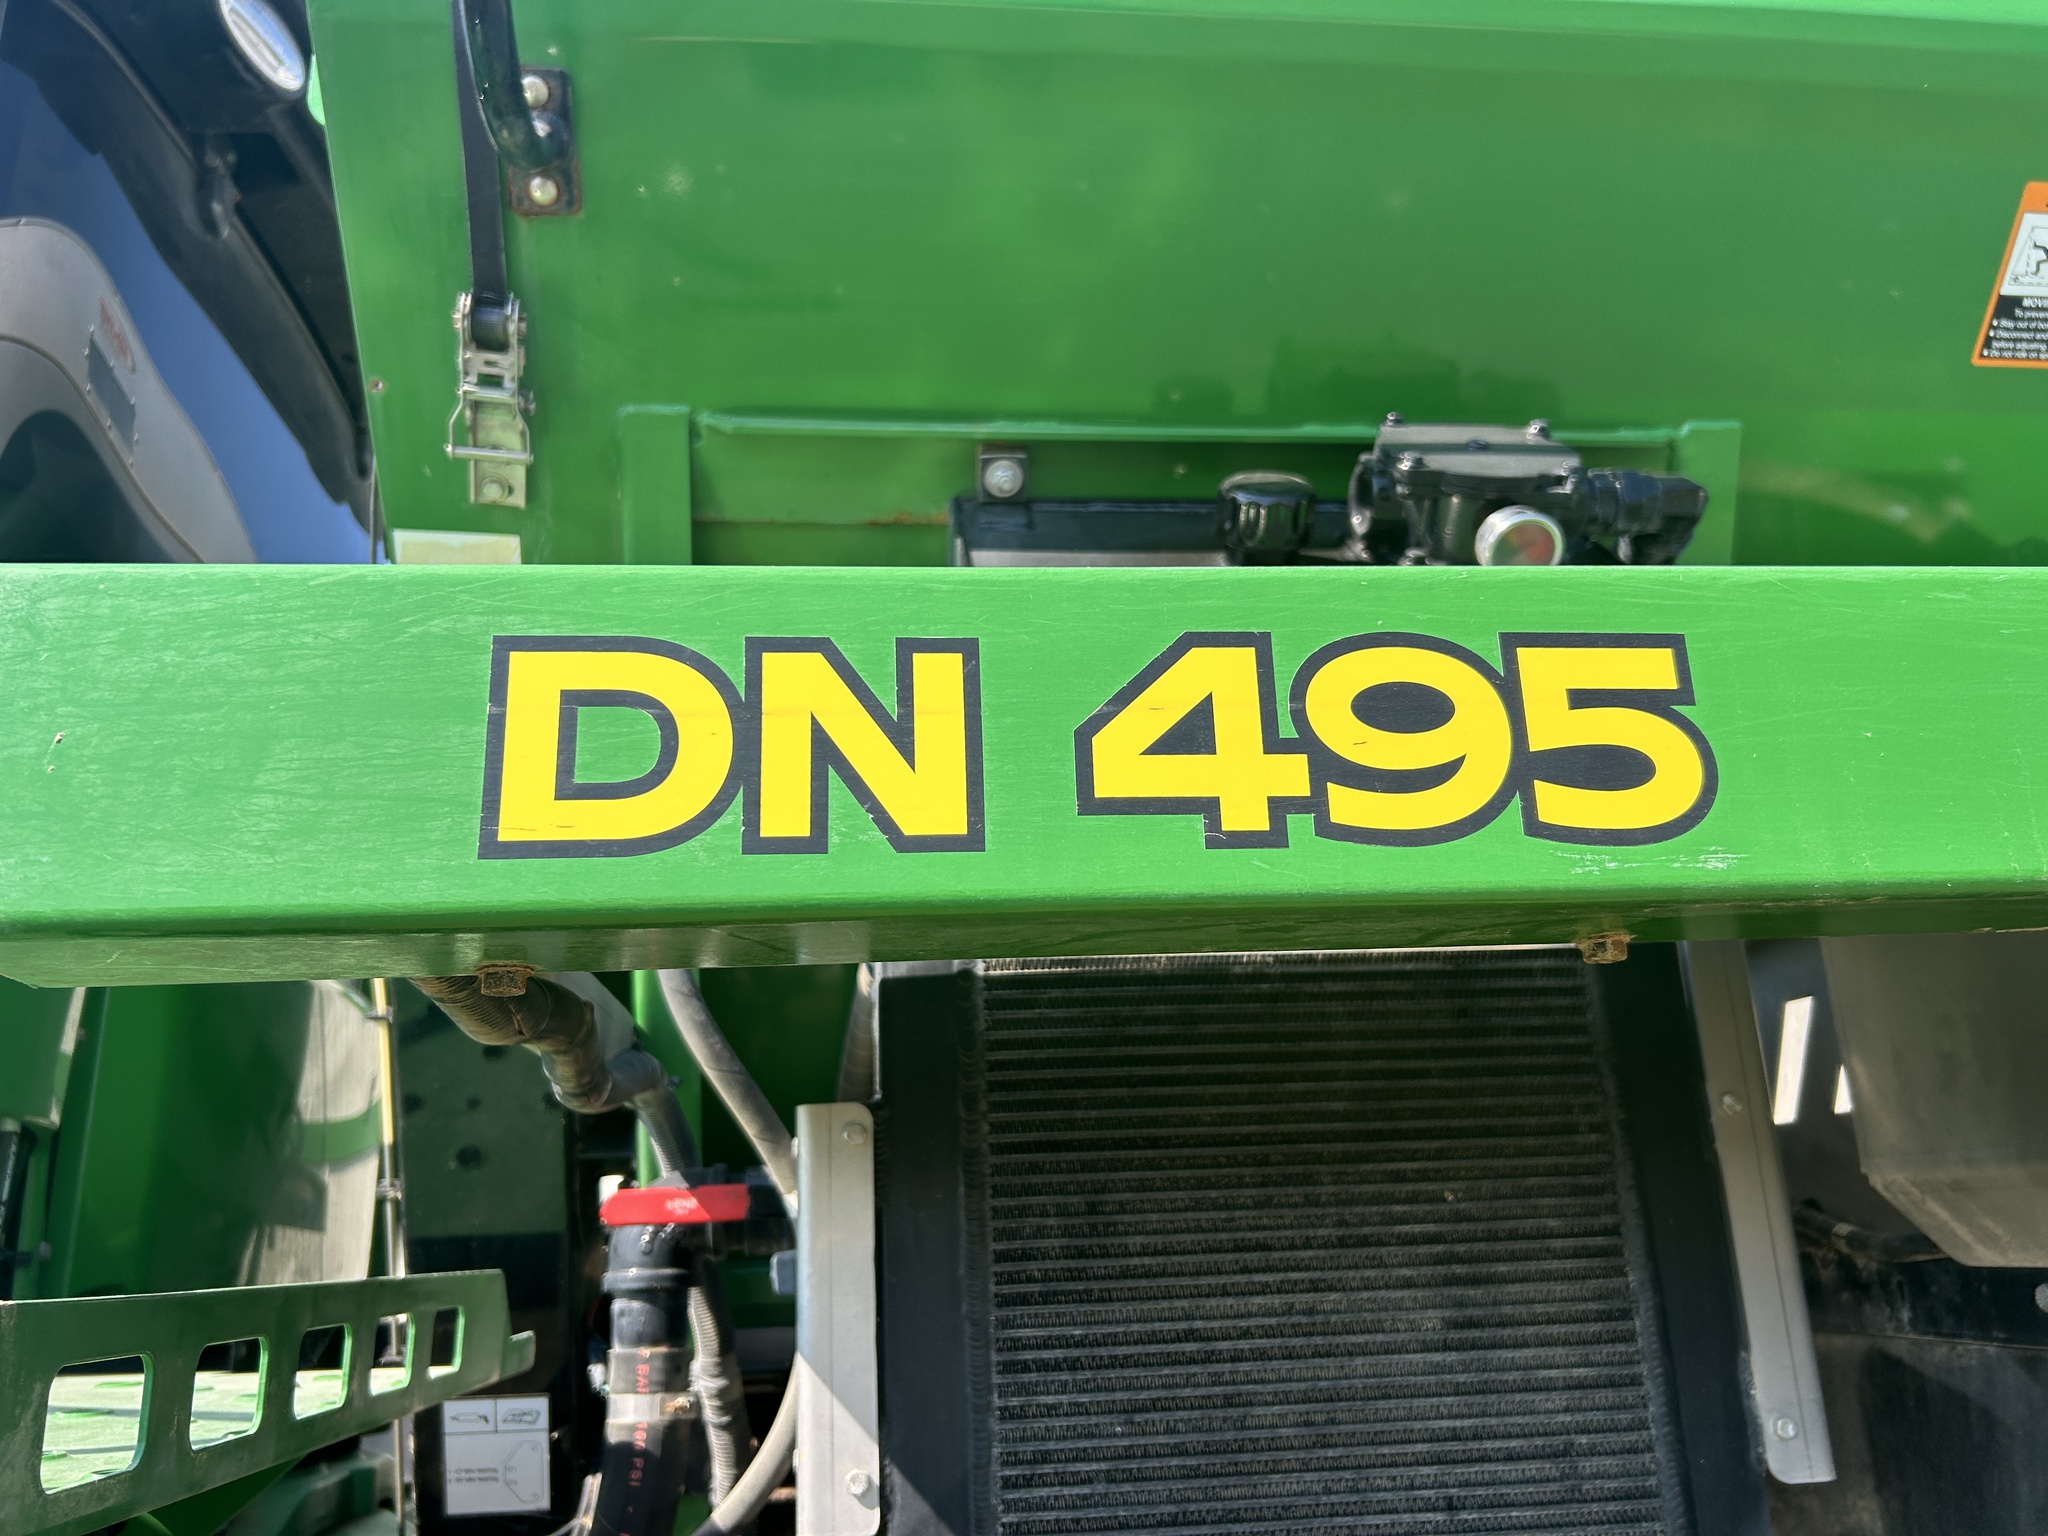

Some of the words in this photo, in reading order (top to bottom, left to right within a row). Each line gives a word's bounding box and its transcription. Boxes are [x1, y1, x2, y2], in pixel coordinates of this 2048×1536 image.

[2022, 297, 2048, 308] MOVI
[2014, 308, 2024, 318] To
[1999, 318, 2015, 330] Stay
[2016, 319, 2028, 330] out
[2028, 320, 2037, 330] of
[1995, 328, 2035, 340] Disconnect
[1989, 349, 2001, 358] Do
[2001, 350, 2014, 359] not
[478, 635, 986, 859] DN
[1074, 631, 1719, 849] 495
[628, 1457, 644, 1486] PSI
